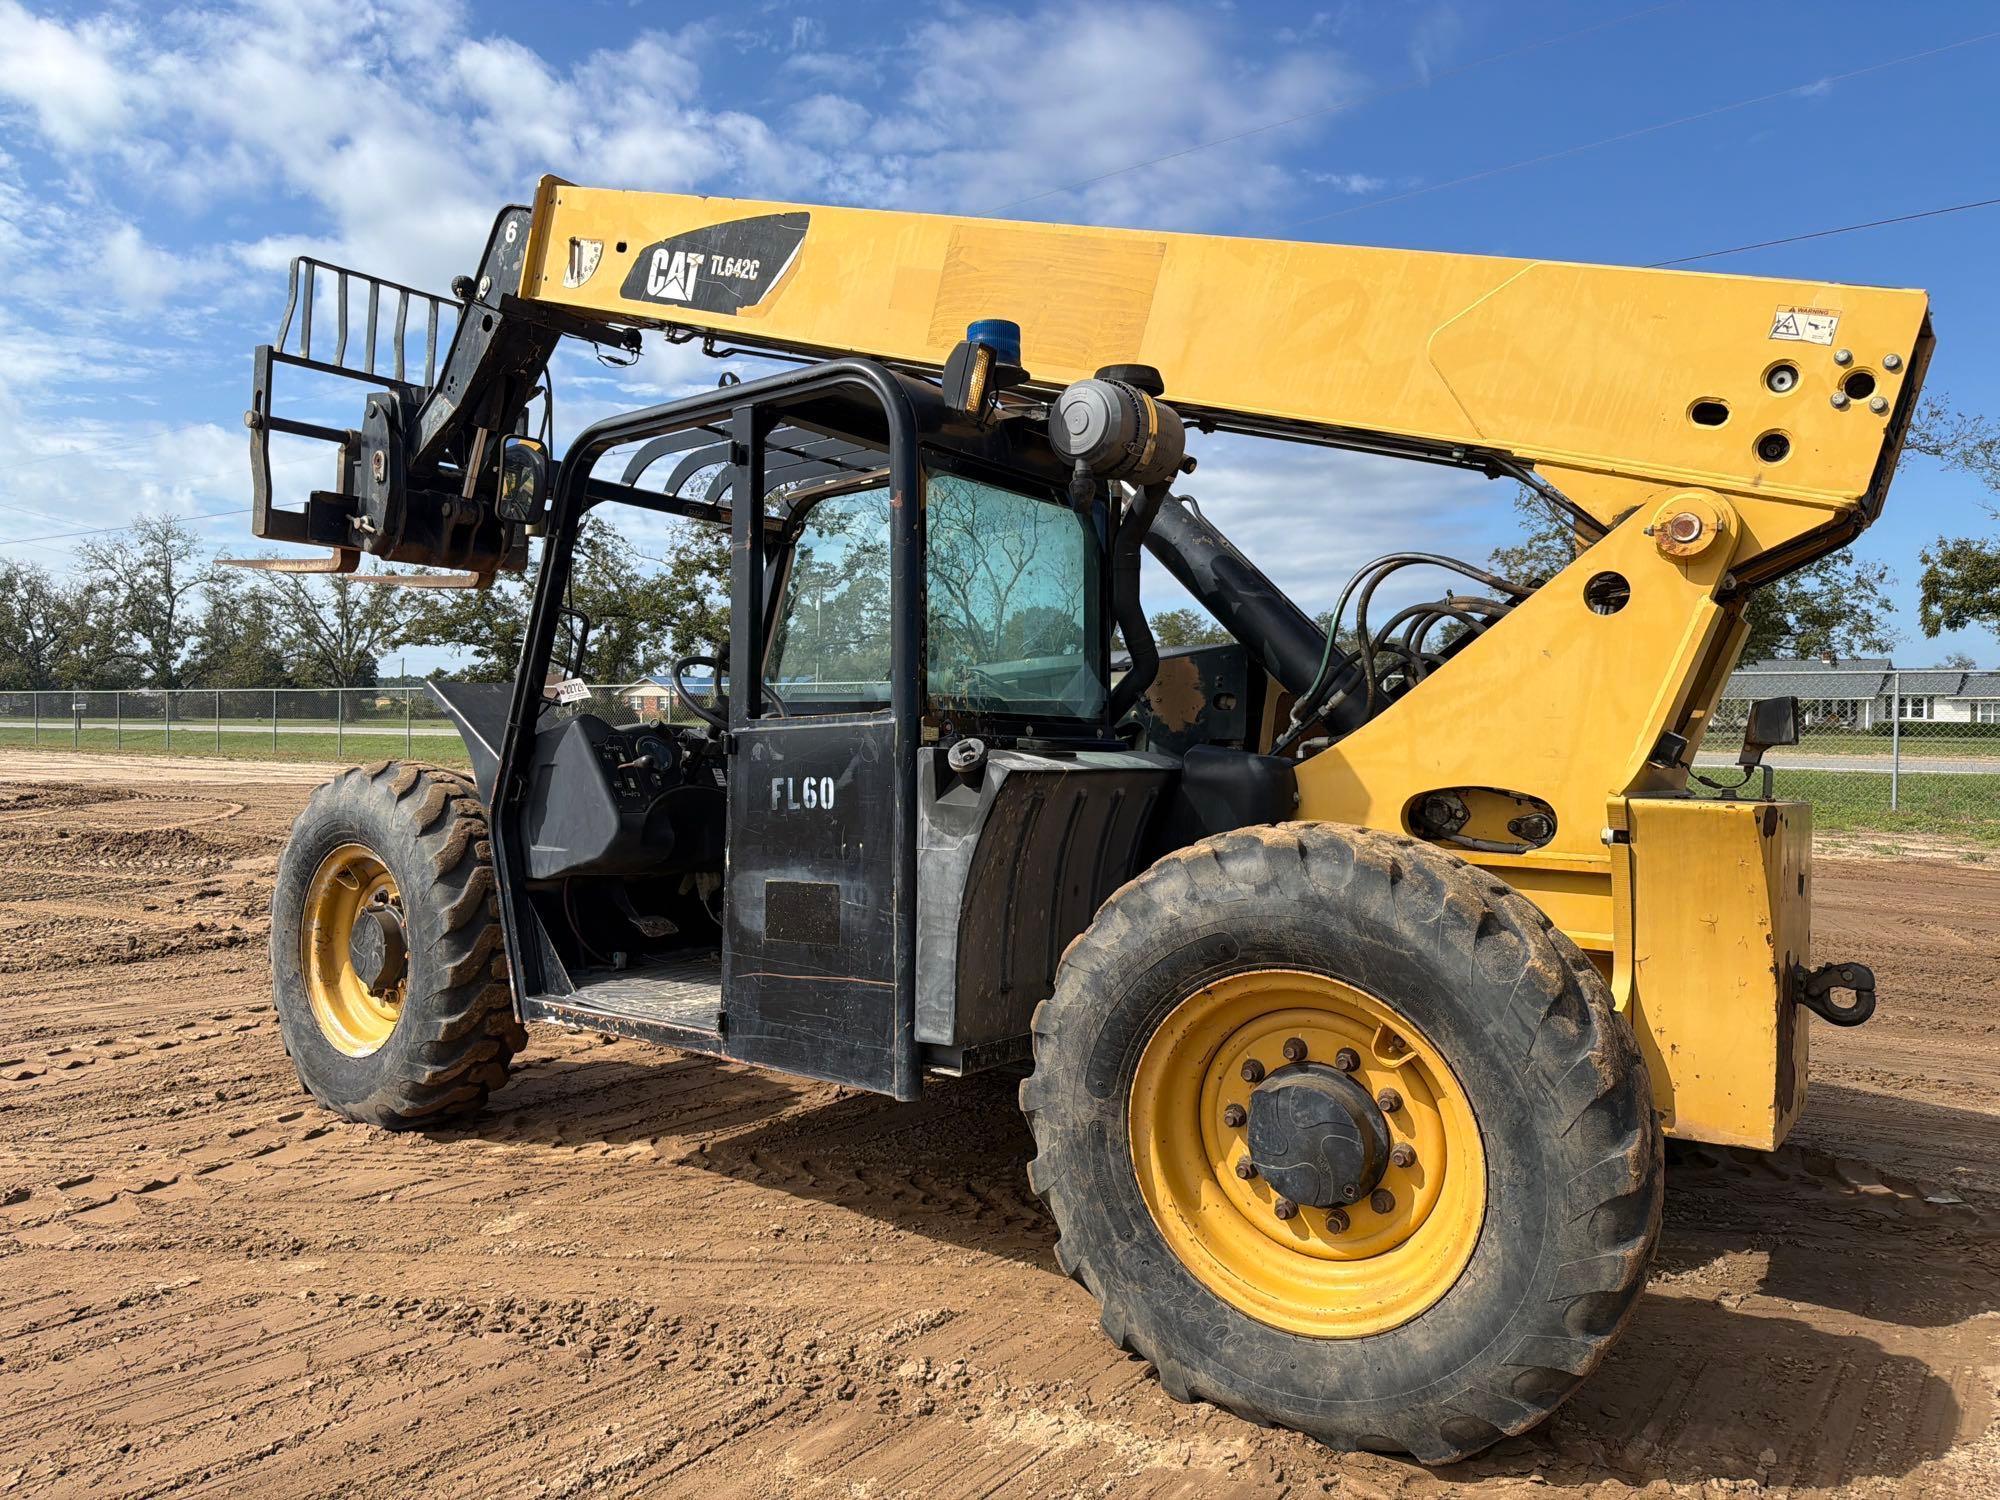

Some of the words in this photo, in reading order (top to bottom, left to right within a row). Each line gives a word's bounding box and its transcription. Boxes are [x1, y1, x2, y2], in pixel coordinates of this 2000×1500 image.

[505, 221, 518, 243] 6
[647, 248, 705, 302] CAT
[710, 255, 760, 281] TL642C
[1797, 307, 1829, 315] WARNING
[771, 776, 835, 811] FL60
